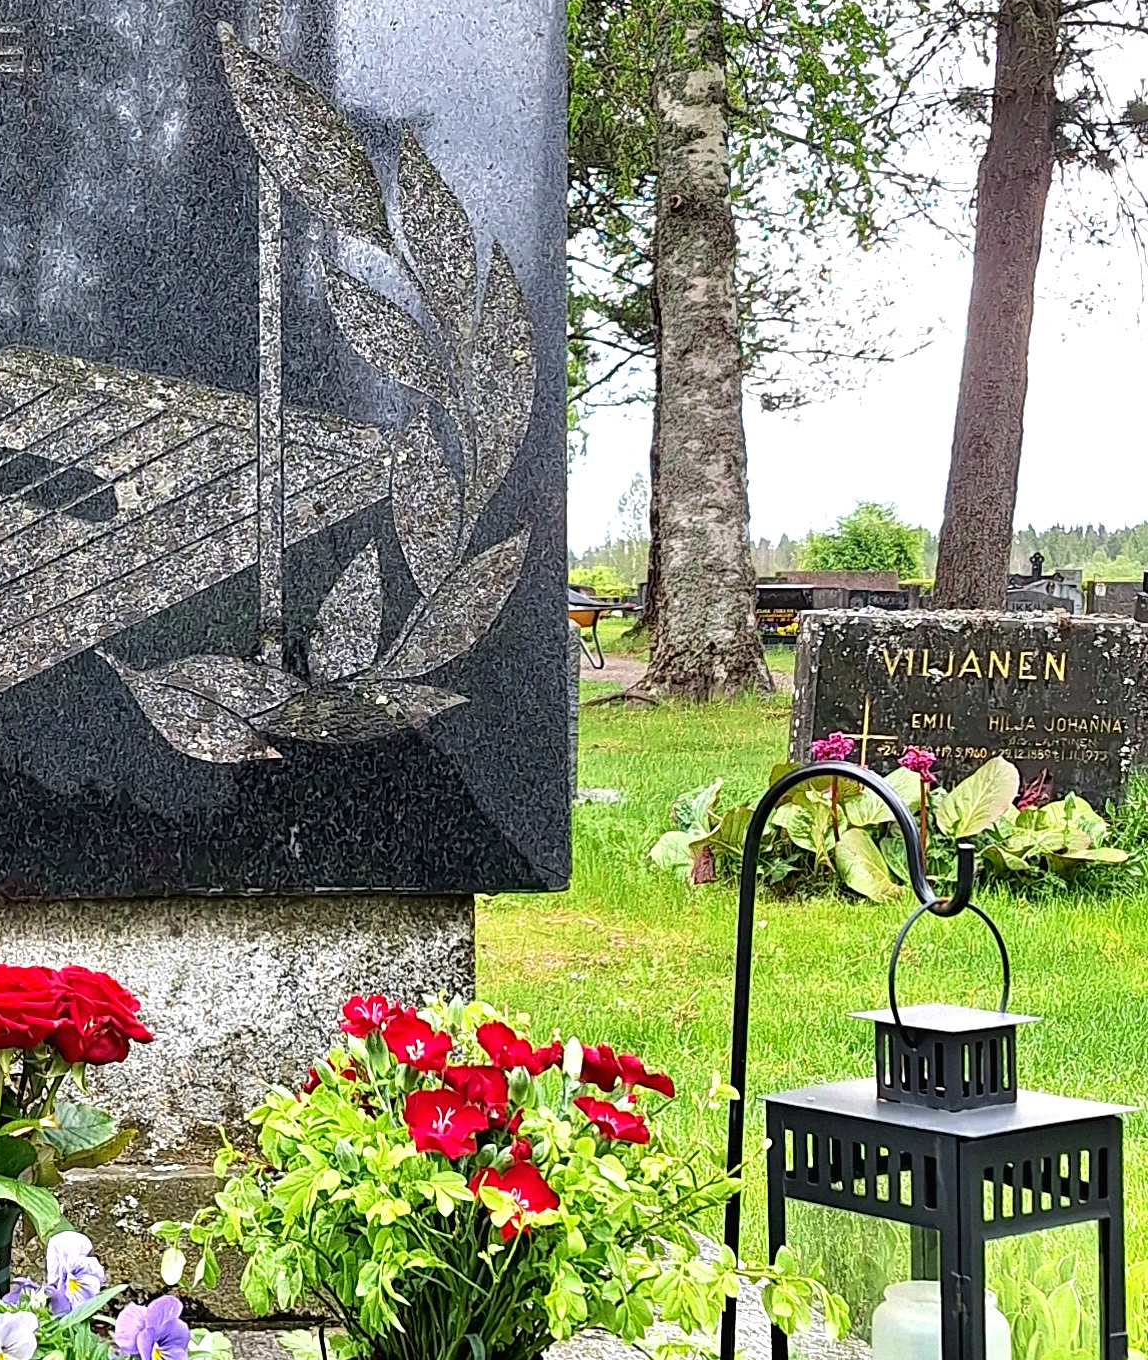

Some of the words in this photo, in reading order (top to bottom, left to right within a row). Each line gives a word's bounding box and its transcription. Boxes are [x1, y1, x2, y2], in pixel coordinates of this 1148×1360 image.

[882, 648, 1069, 682] VILJANEN
[910, 712, 956, 730] EMIL
[988, 714, 1037, 732] HILJA
[1044, 717, 1123, 734] JOHANNA
